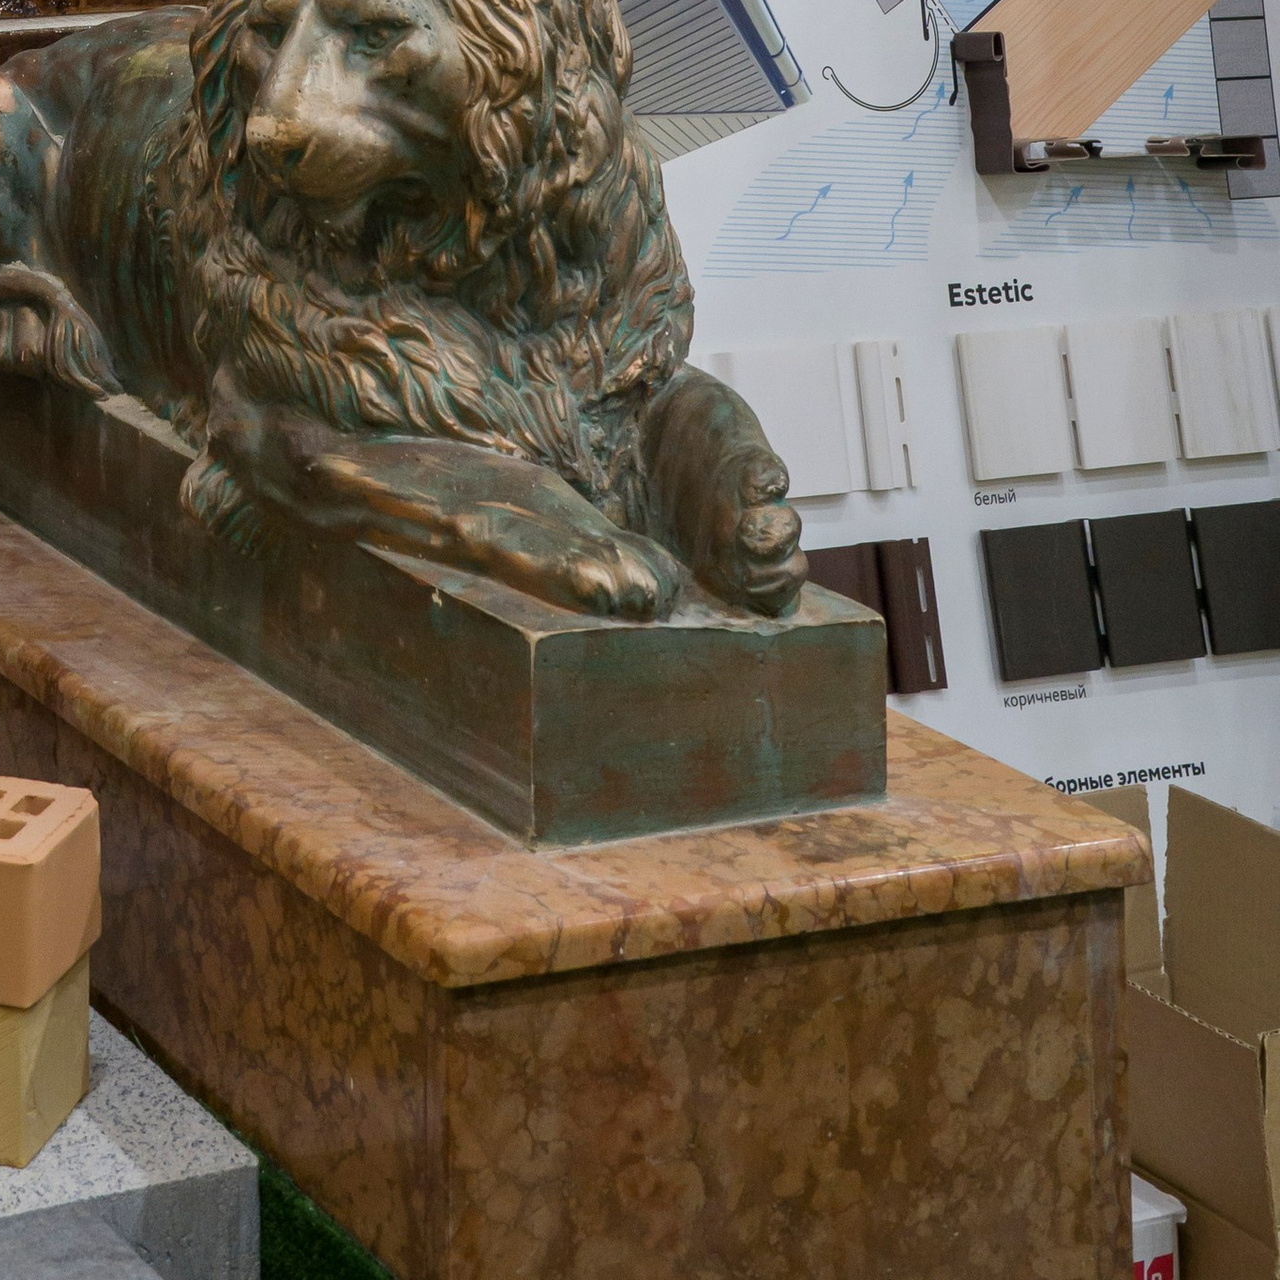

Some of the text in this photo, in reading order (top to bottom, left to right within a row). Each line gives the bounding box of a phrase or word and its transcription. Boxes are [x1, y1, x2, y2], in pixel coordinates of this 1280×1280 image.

[948, 278, 1034, 307] Estetic
[974, 489, 1017, 506] белый
[1004, 684, 1087, 710] коричневый
[1118, 762, 1205, 786] элементы
